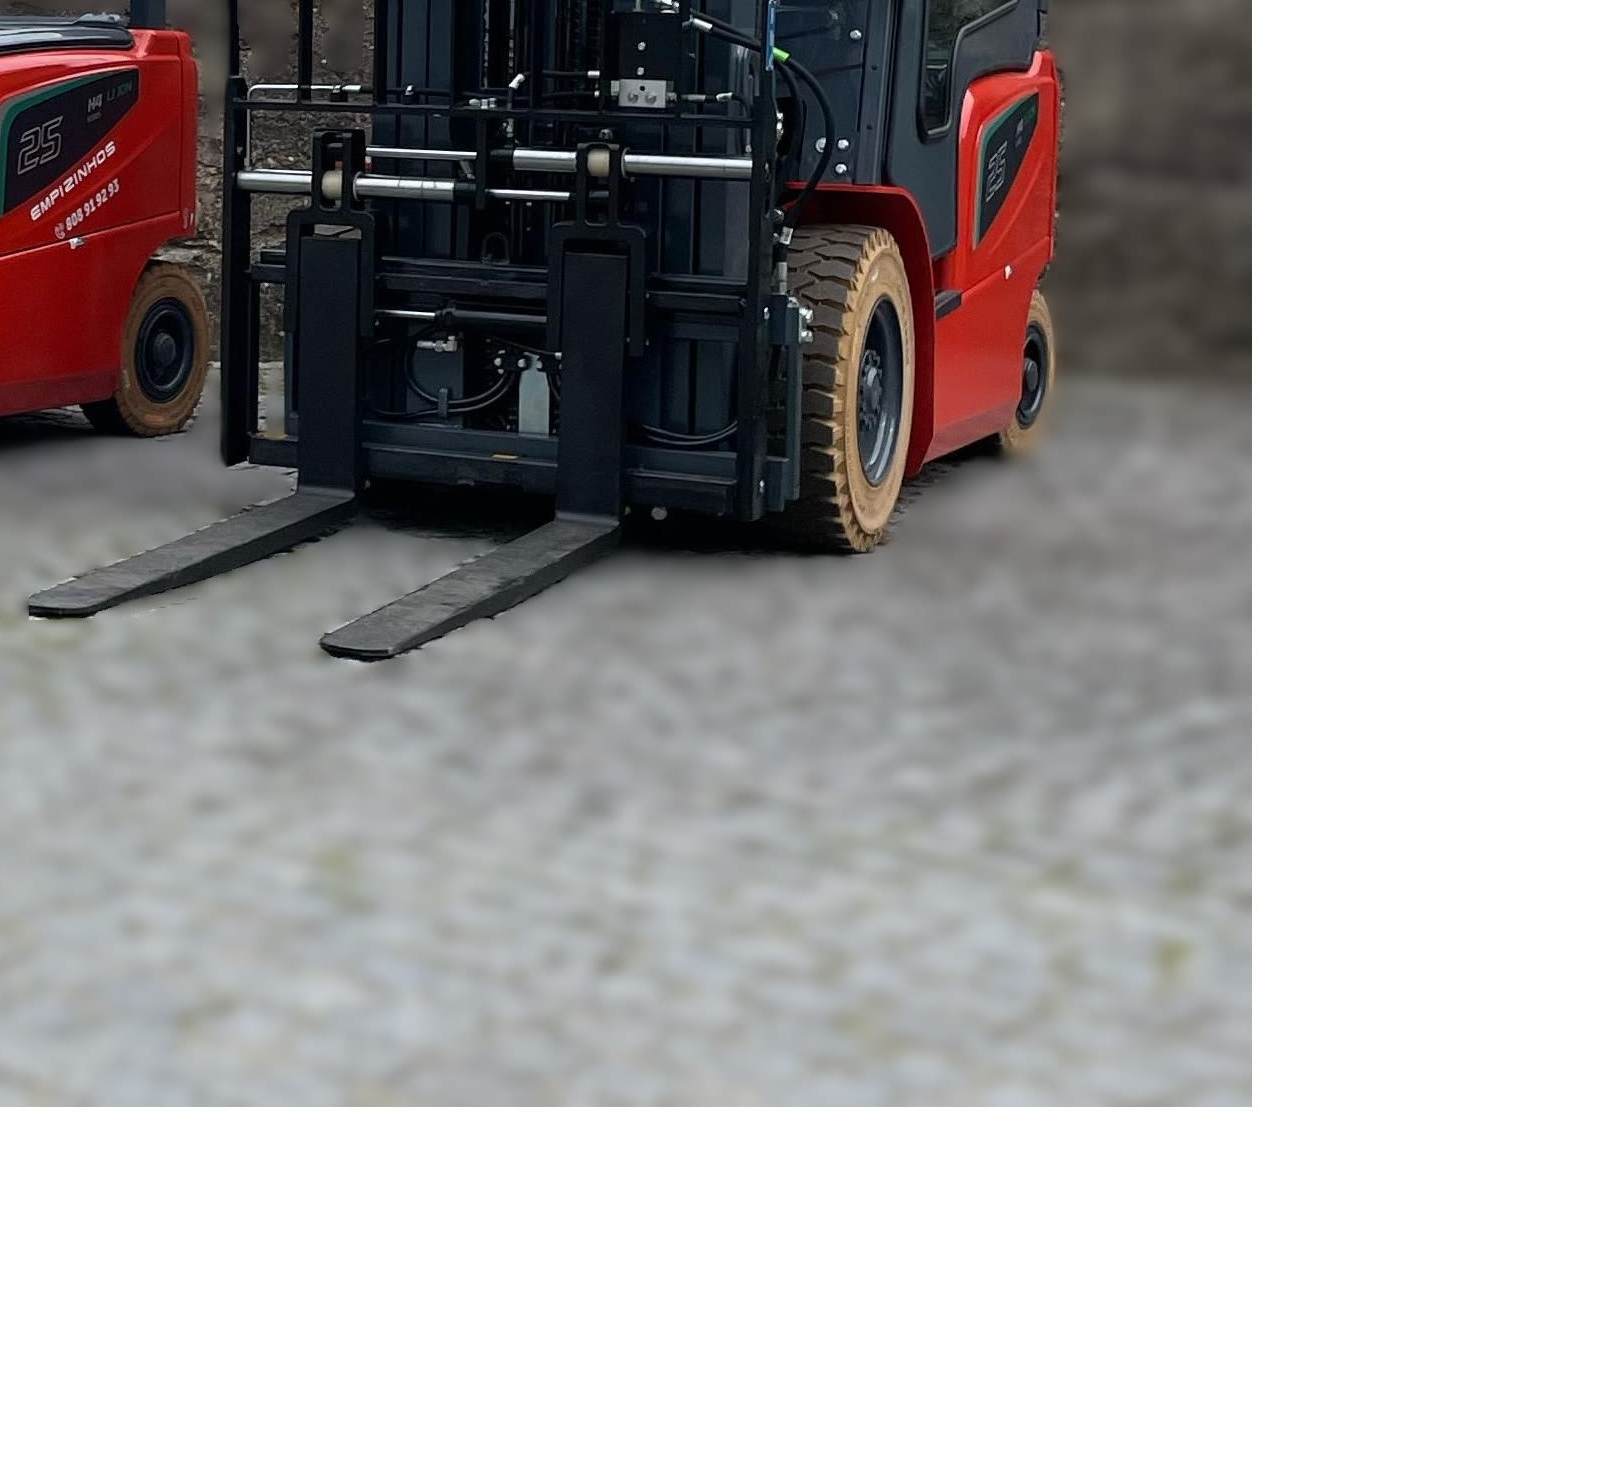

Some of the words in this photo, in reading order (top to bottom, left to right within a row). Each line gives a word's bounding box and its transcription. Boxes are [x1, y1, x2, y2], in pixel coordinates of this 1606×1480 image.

[17, 115, 64, 175] 25
[30, 140, 116, 221] EMPIZINHOS
[84, 199, 96, 216] 91
[95, 188, 108, 207] 92
